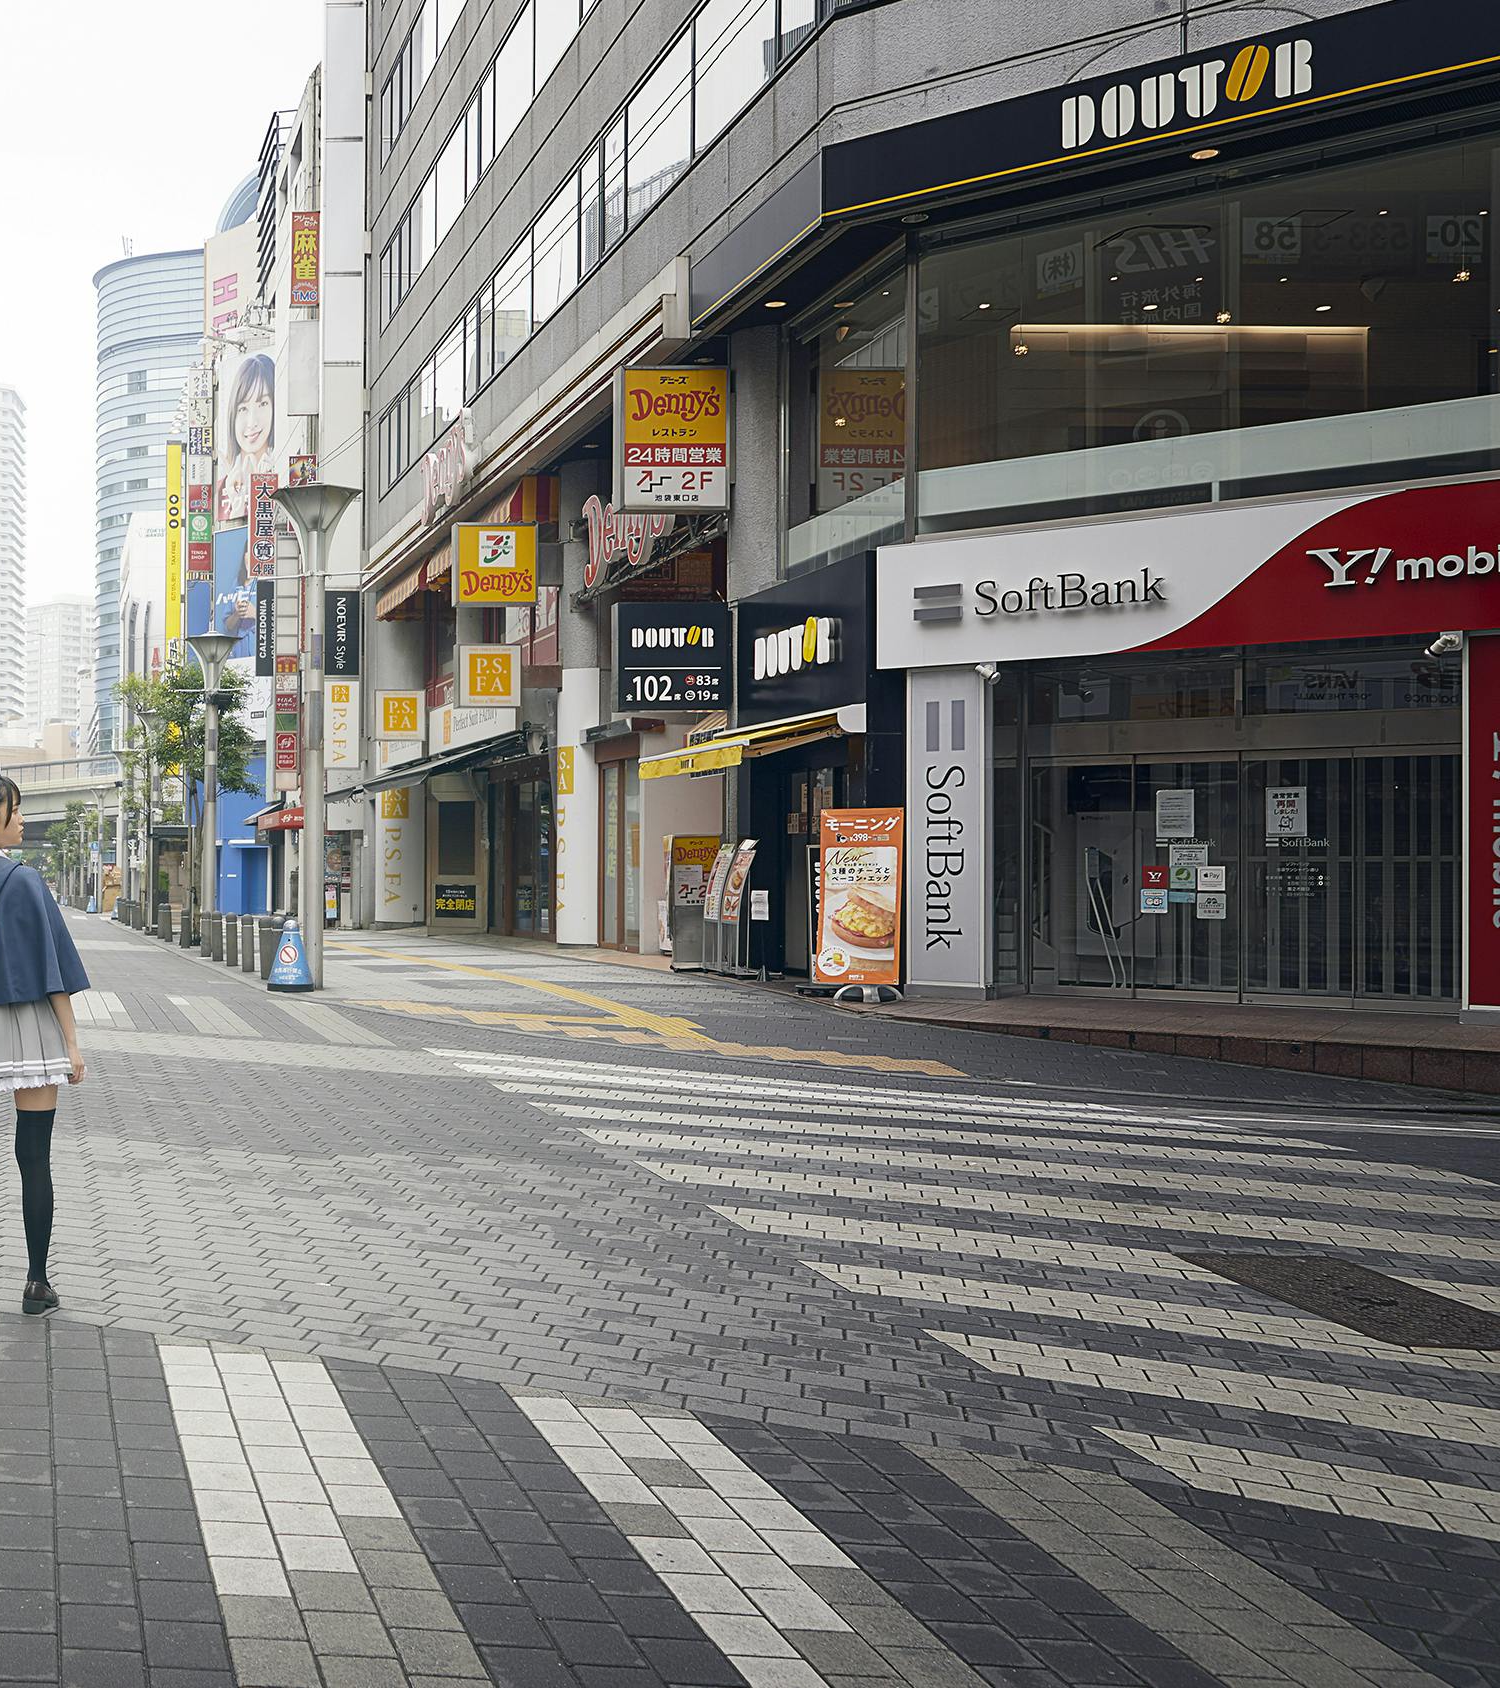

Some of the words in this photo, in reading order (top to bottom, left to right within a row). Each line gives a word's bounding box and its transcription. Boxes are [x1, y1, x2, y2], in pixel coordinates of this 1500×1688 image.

[1061, 39, 1313, 149] DOUTOR
[293, 228, 318, 280] 麻雀
[292, 290, 318, 302] TMC
[629, 386, 721, 423] Denny's
[652, 428, 698, 437] レストラン
[627, 447, 723, 464] 24時間営業
[681, 471, 713, 490] 2F
[255, 482, 274, 538] 大黒屋
[461, 568, 533, 597] Denny's
[974, 567, 1167, 617] SoftBank
[259, 599, 267, 659] CALZEDONIA
[631, 624, 715, 649] DOUTOR
[754, 616, 834, 681] DOUTOR
[475, 657, 508, 674] P.S.
[388, 700, 415, 714] P.S.
[825, 816, 901, 832] モーニング
[1282, 837, 1331, 848] SoftBank
[675, 845, 719, 862] Denny's
[823, 848, 874, 872] New
[925, 765, 966, 950] SoftBank
[831, 867, 891, 875] 3種のチーズと
[435, 898, 476, 911] 完全閉店
